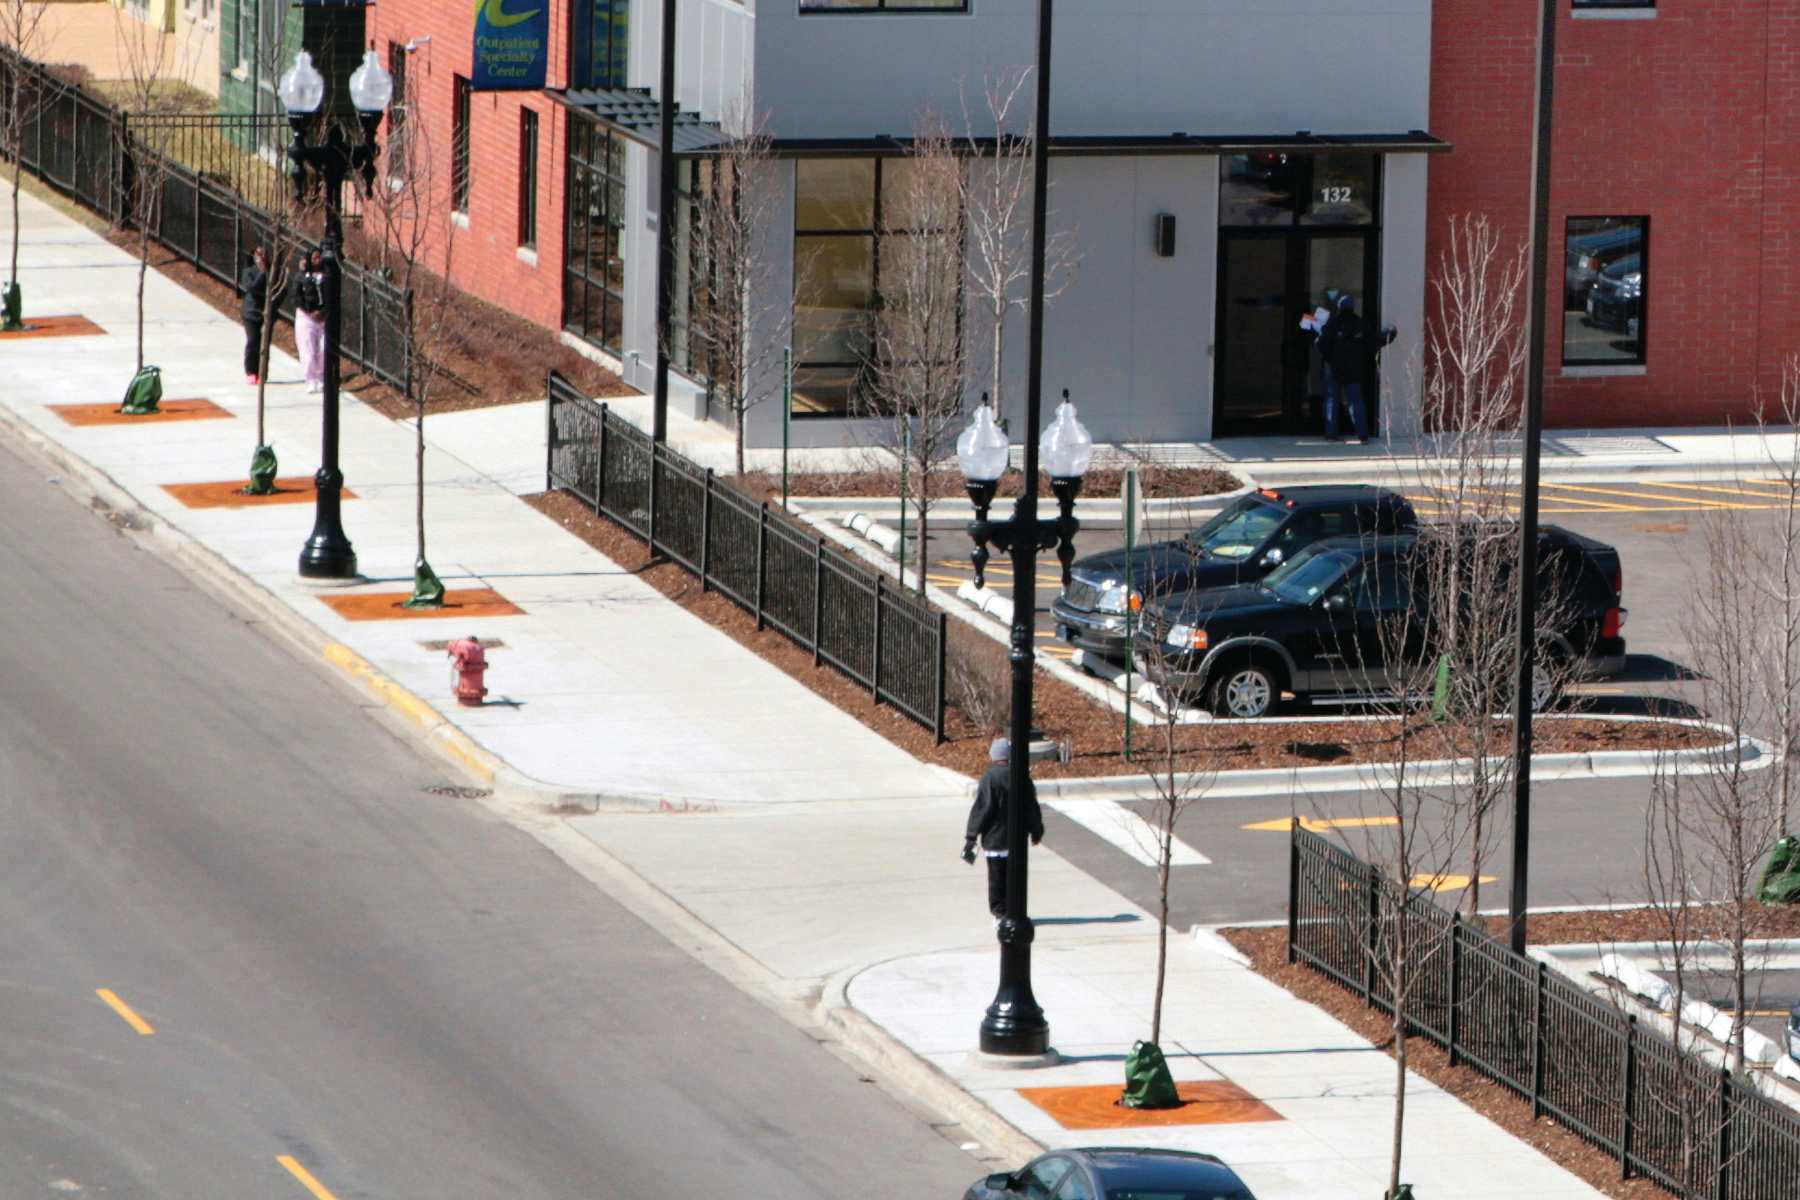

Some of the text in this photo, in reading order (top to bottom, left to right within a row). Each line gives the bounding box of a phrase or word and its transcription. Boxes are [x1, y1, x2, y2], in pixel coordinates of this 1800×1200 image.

[479, 50, 536, 65] Specialty
[487, 63, 529, 77] Center
[1320, 186, 1351, 202] 132
